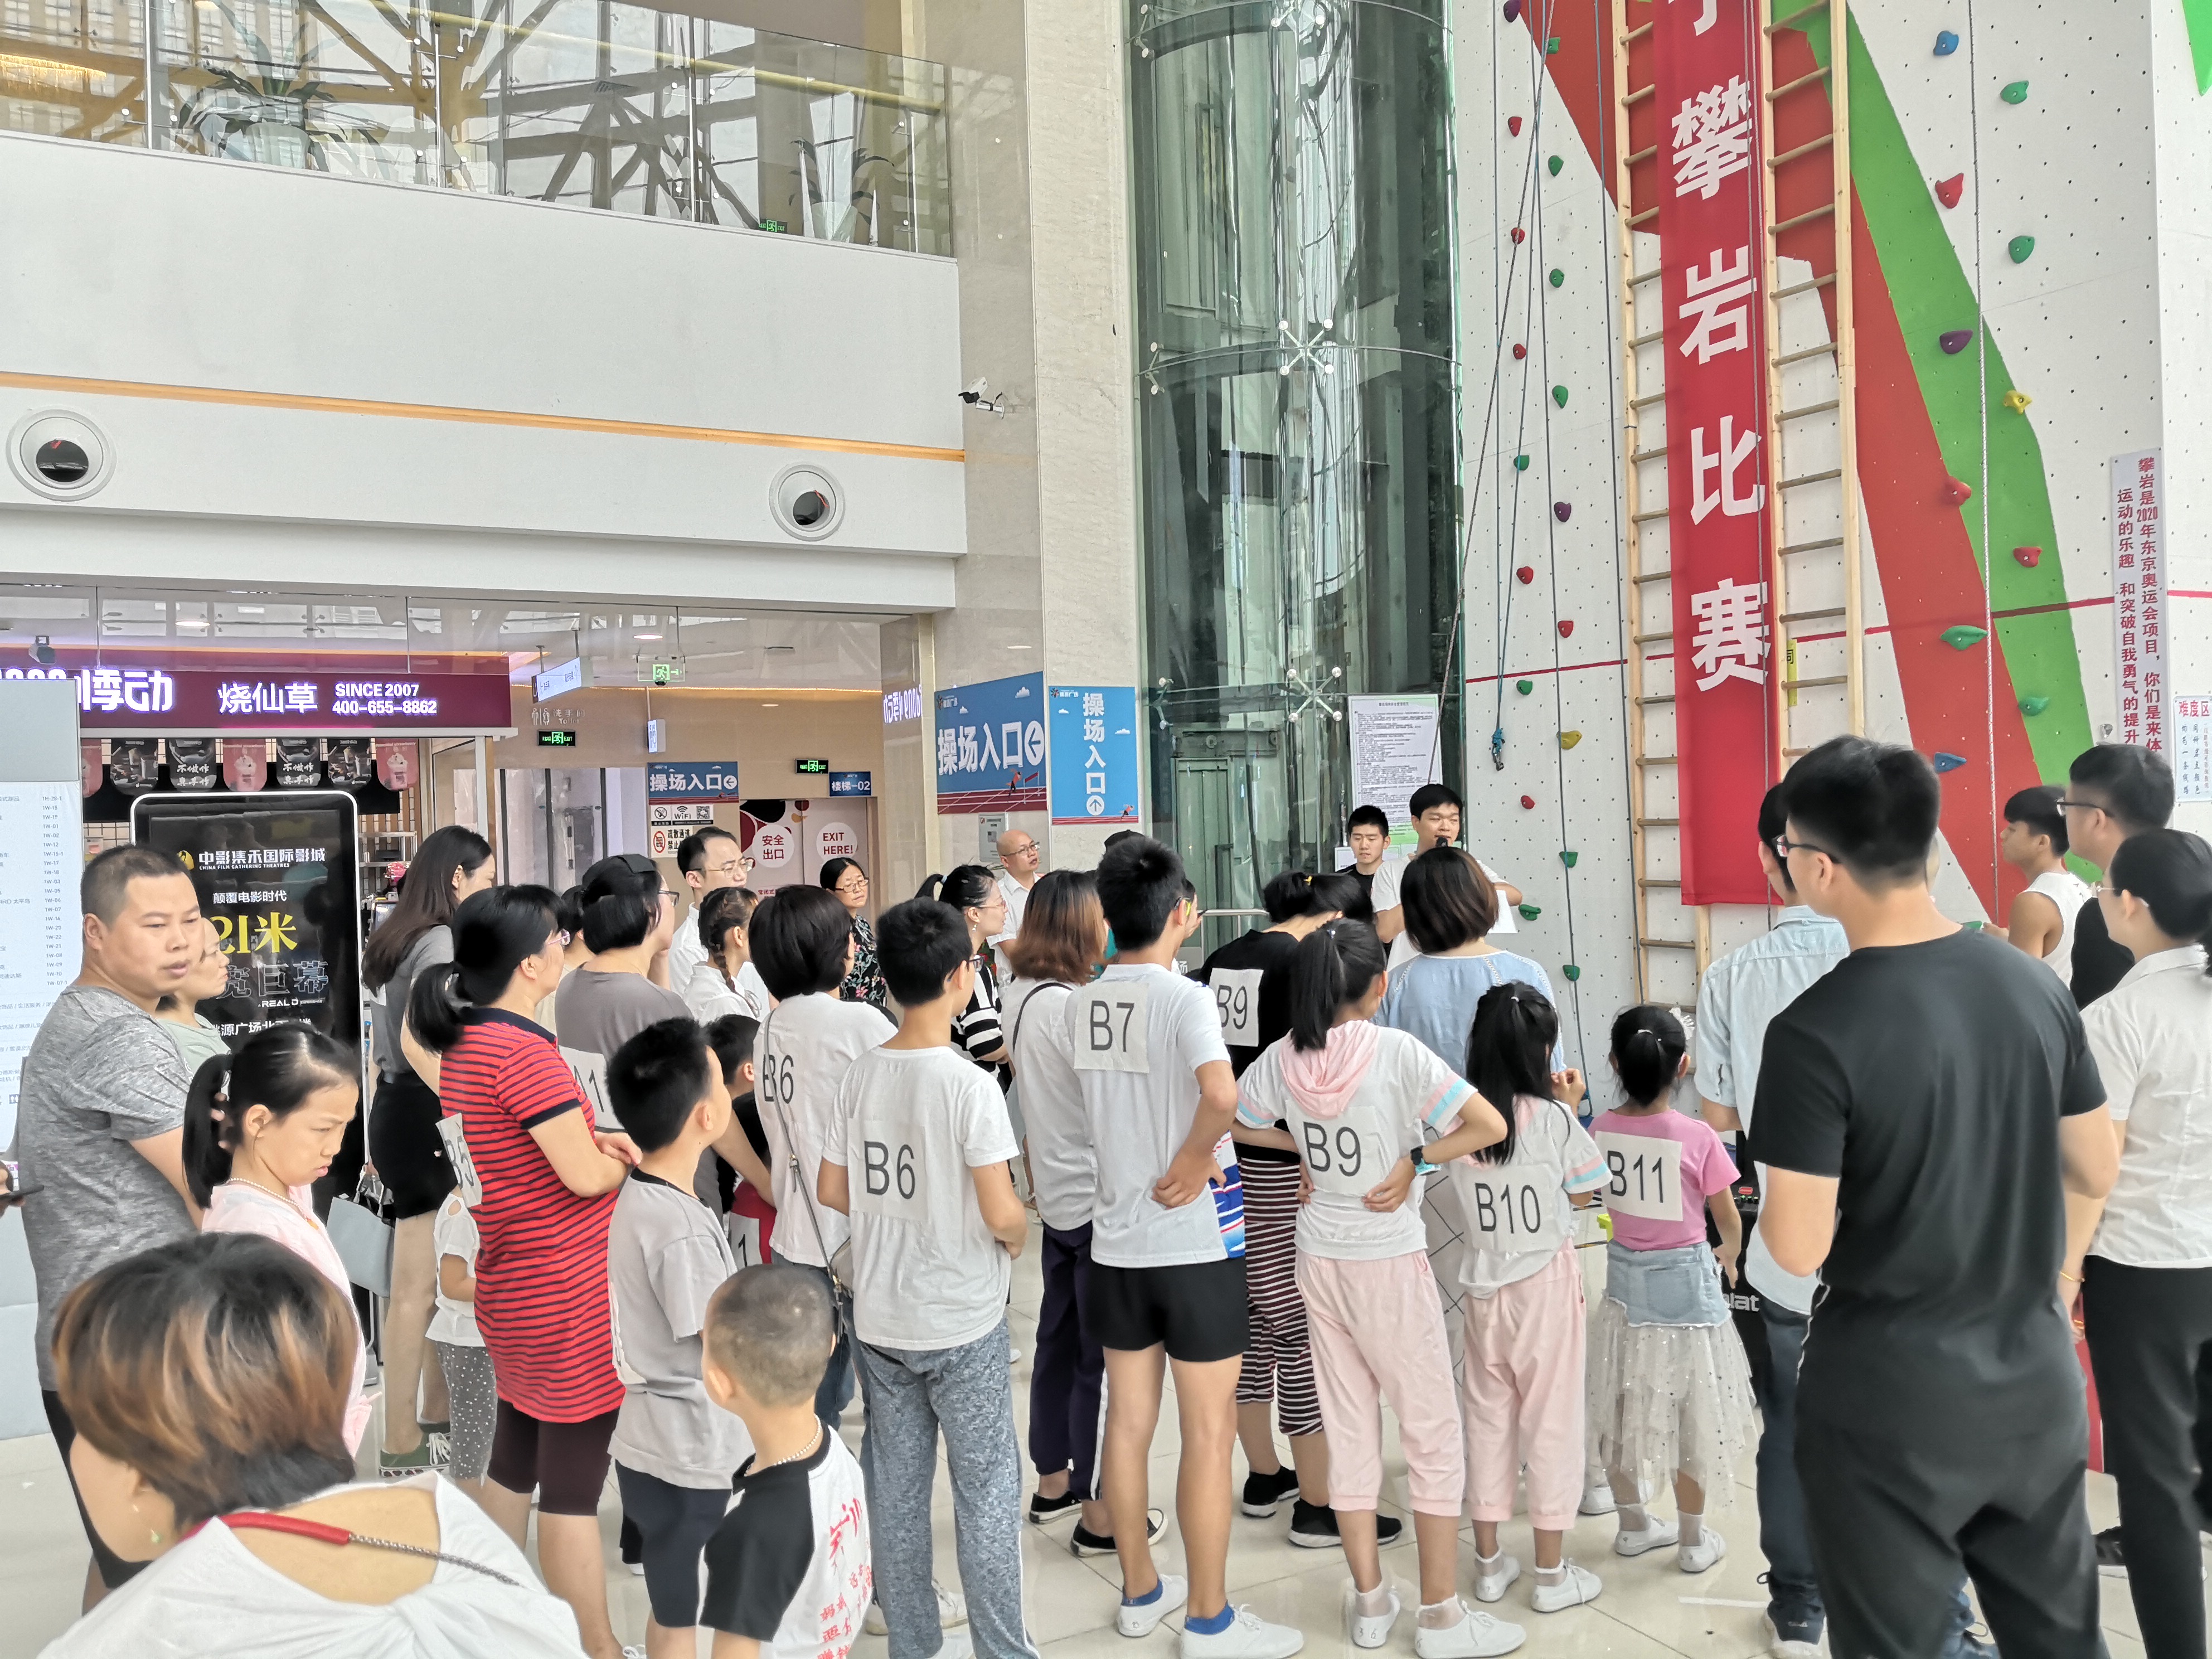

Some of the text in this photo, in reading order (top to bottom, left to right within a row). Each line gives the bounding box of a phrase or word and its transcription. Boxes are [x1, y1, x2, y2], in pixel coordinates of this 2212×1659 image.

[2117, 488, 2135, 569] 运动的乐趣
[218, 682, 318, 714] 烧仙草
[332, 700, 438, 714] 400-655-8862
[335, 683, 419, 697] SINCE 2007
[2179, 700, 2210, 717] 难度区
[938, 721, 1023, 776] 操场入口
[1083, 692, 1107, 794] 操场入口
[649, 773, 722, 792] 操场入口
[762, 835, 784, 846] 安全
[763, 849, 784, 860] 出口
[823, 832, 845, 841] EXIT
[824, 845, 853, 855] HERE!
[213, 890, 287, 904] 颠覆电影时代
[1090, 1000, 1134, 1052] B7
[1216, 984, 1248, 1030] B9
[763, 1054, 795, 1104] B6
[1303, 1122, 1362, 1177] B9
[864, 1140, 916, 1200] B6
[1607, 1150, 1664, 1204] B11
[1474, 1182, 1540, 1234] B10
